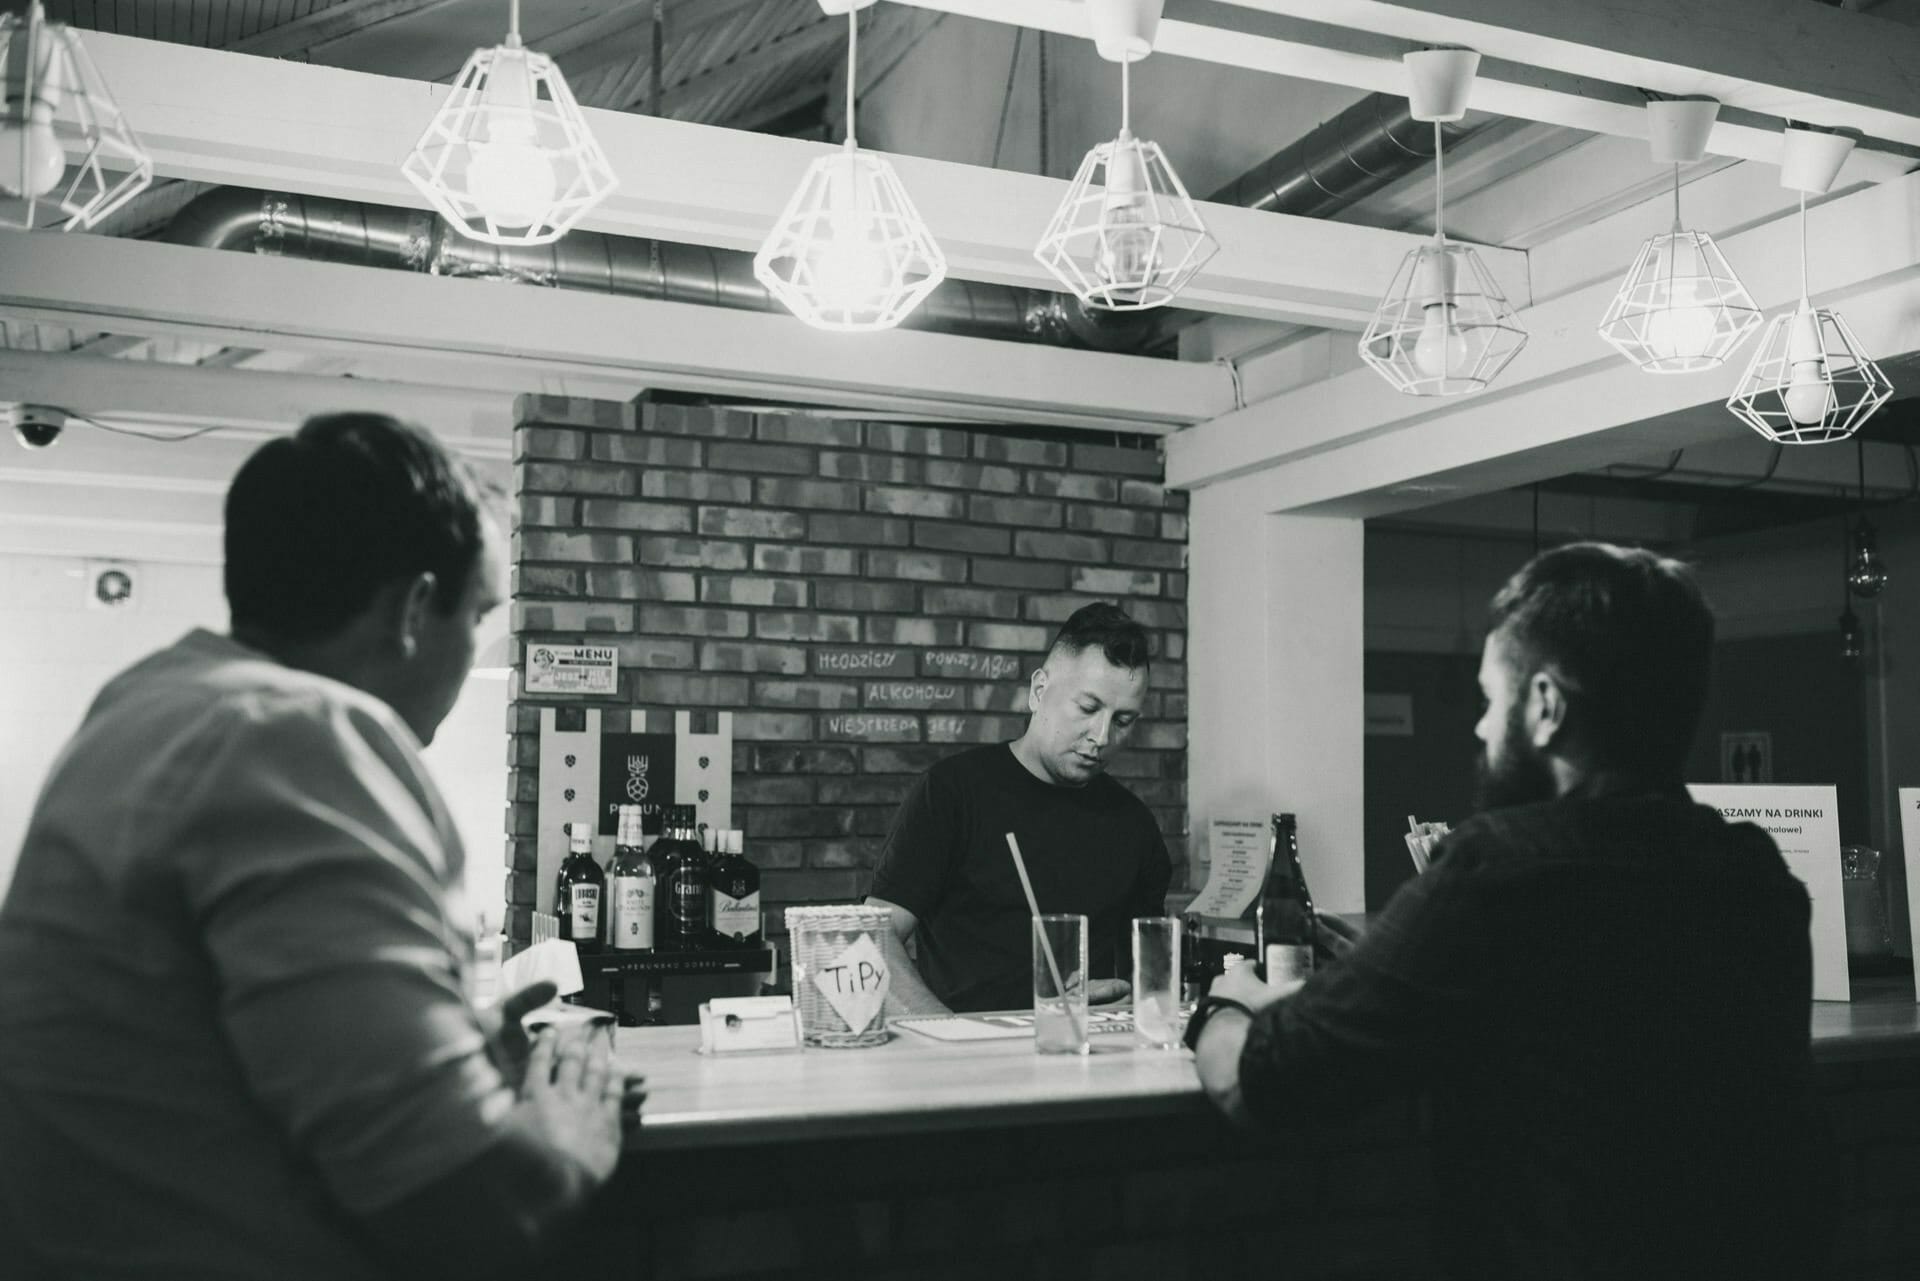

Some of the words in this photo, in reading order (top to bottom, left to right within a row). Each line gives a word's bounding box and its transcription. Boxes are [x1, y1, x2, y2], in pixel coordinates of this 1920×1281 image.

[574, 648, 613, 660] MENU
[1765, 808, 1782, 818] NA
[1784, 808, 1823, 818] DRINKI
